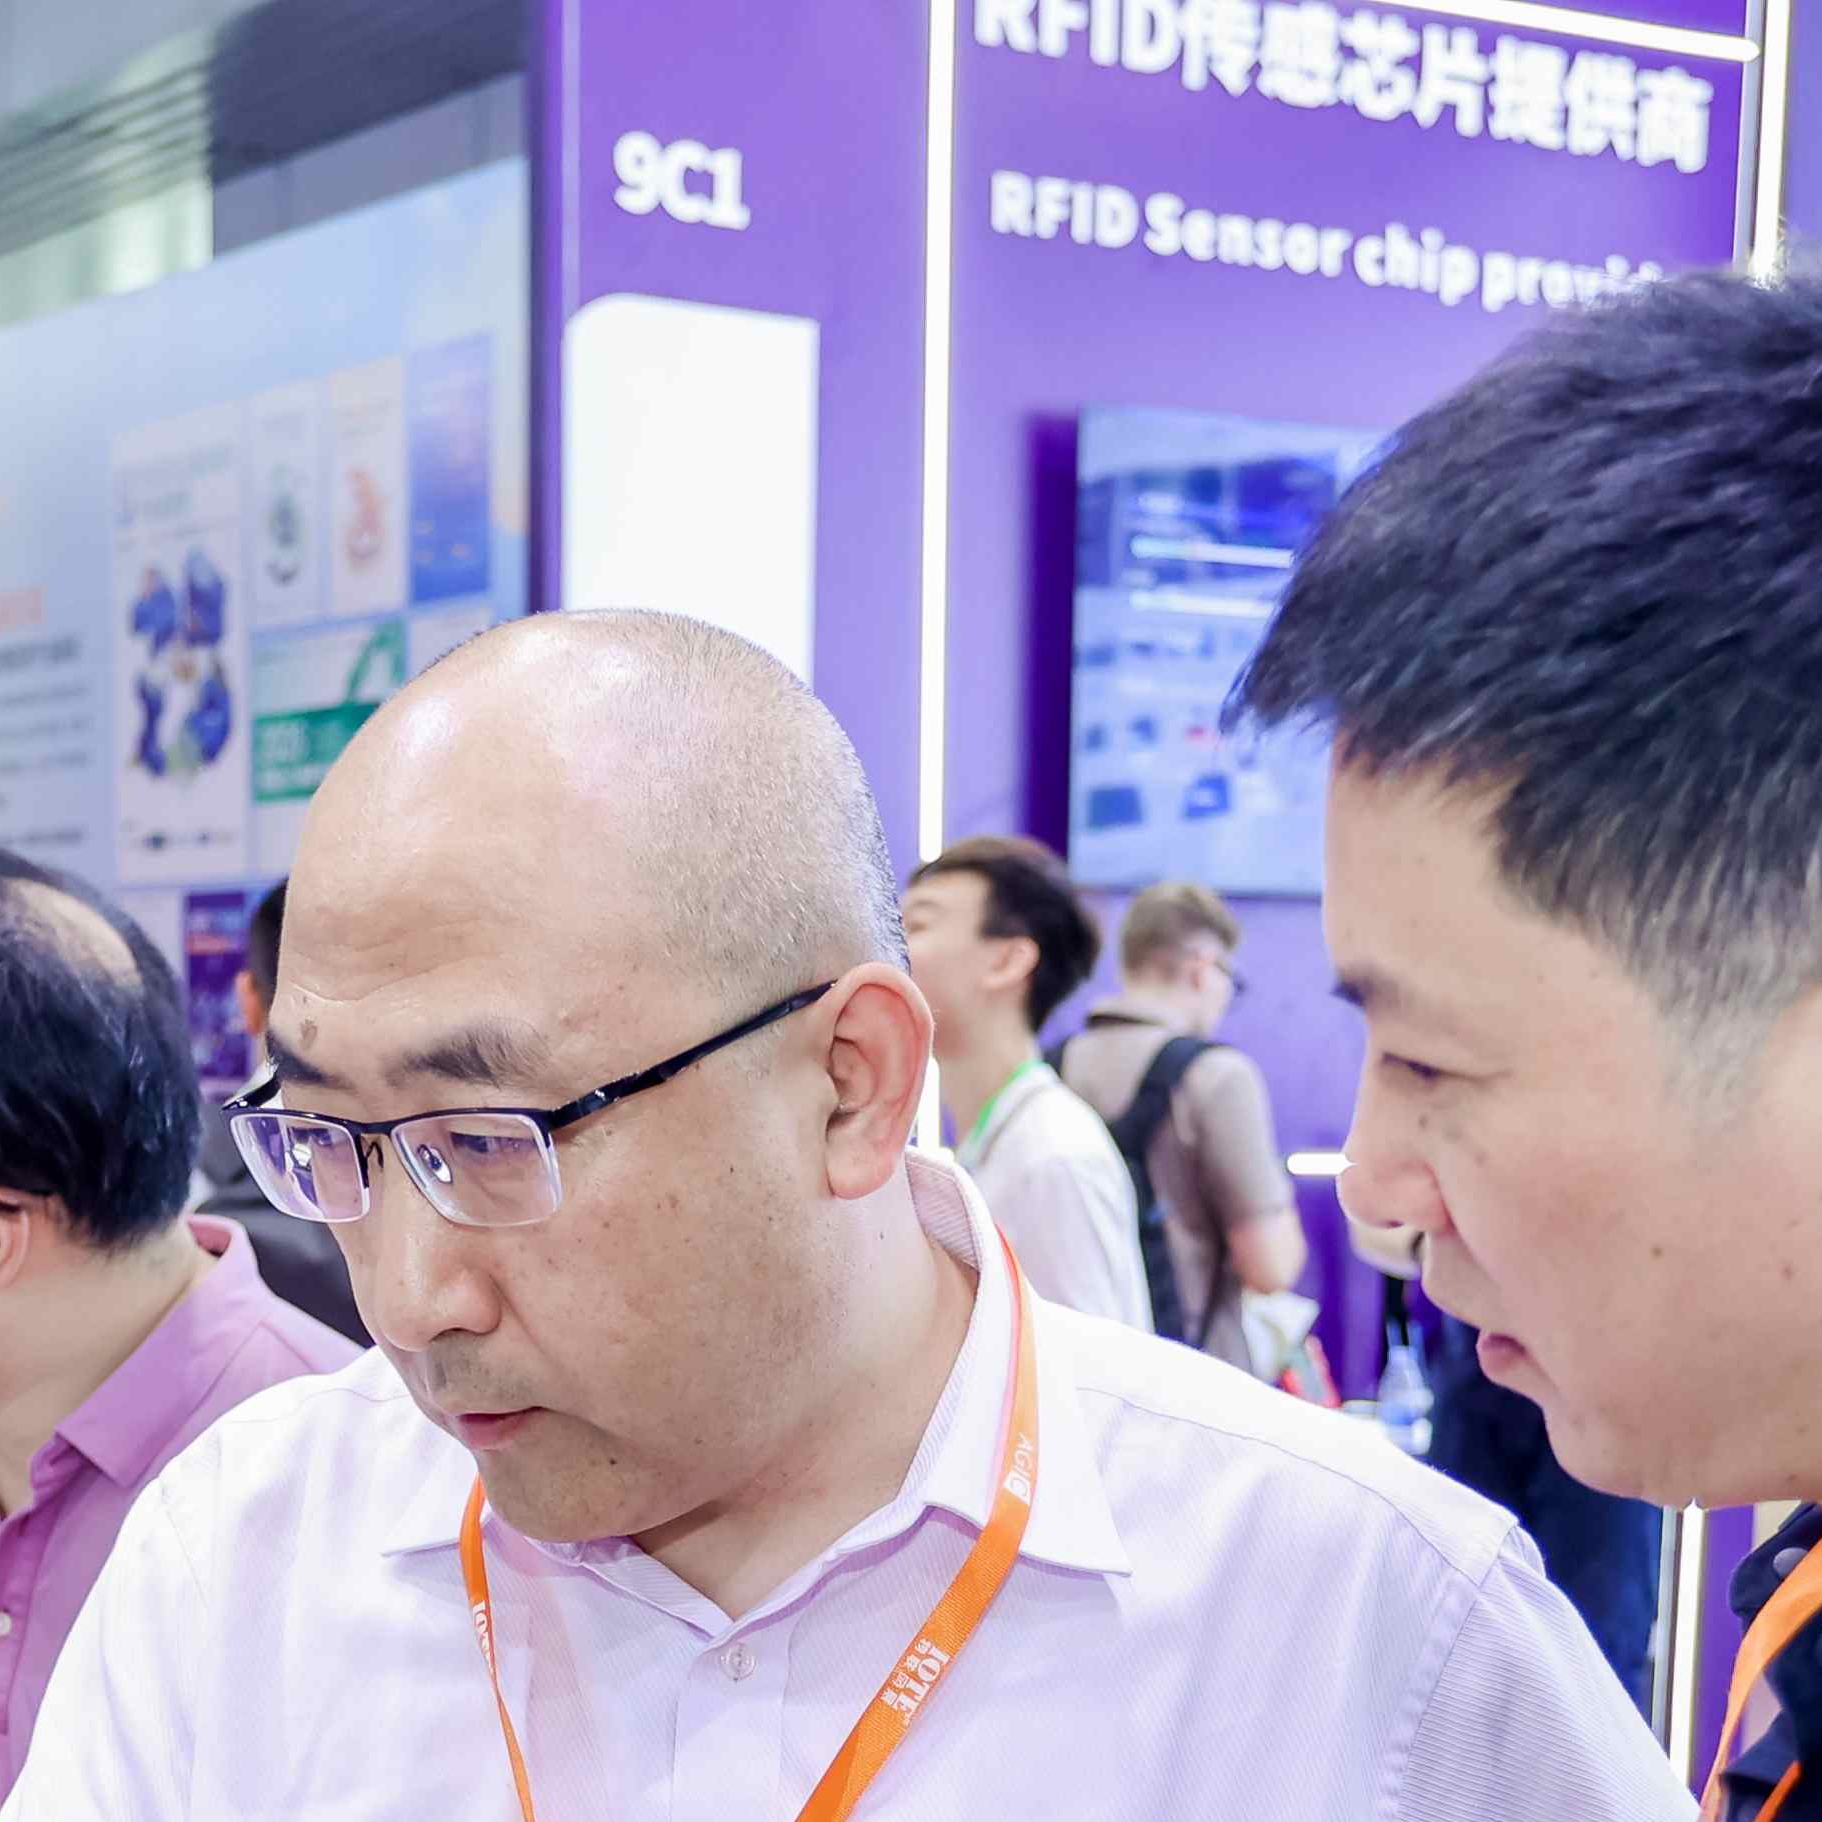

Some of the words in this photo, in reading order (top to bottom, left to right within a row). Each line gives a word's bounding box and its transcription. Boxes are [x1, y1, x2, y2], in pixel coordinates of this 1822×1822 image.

[974, 0, 1714, 173] RFID传感芯片提供商
[612, 131, 751, 231] 9C1
[990, 170, 1141, 248] RFID
[1144, 193, 1355, 278] Sensor
[1354, 223, 1480, 308] chip
[894, 1646, 951, 1714] IOTE
